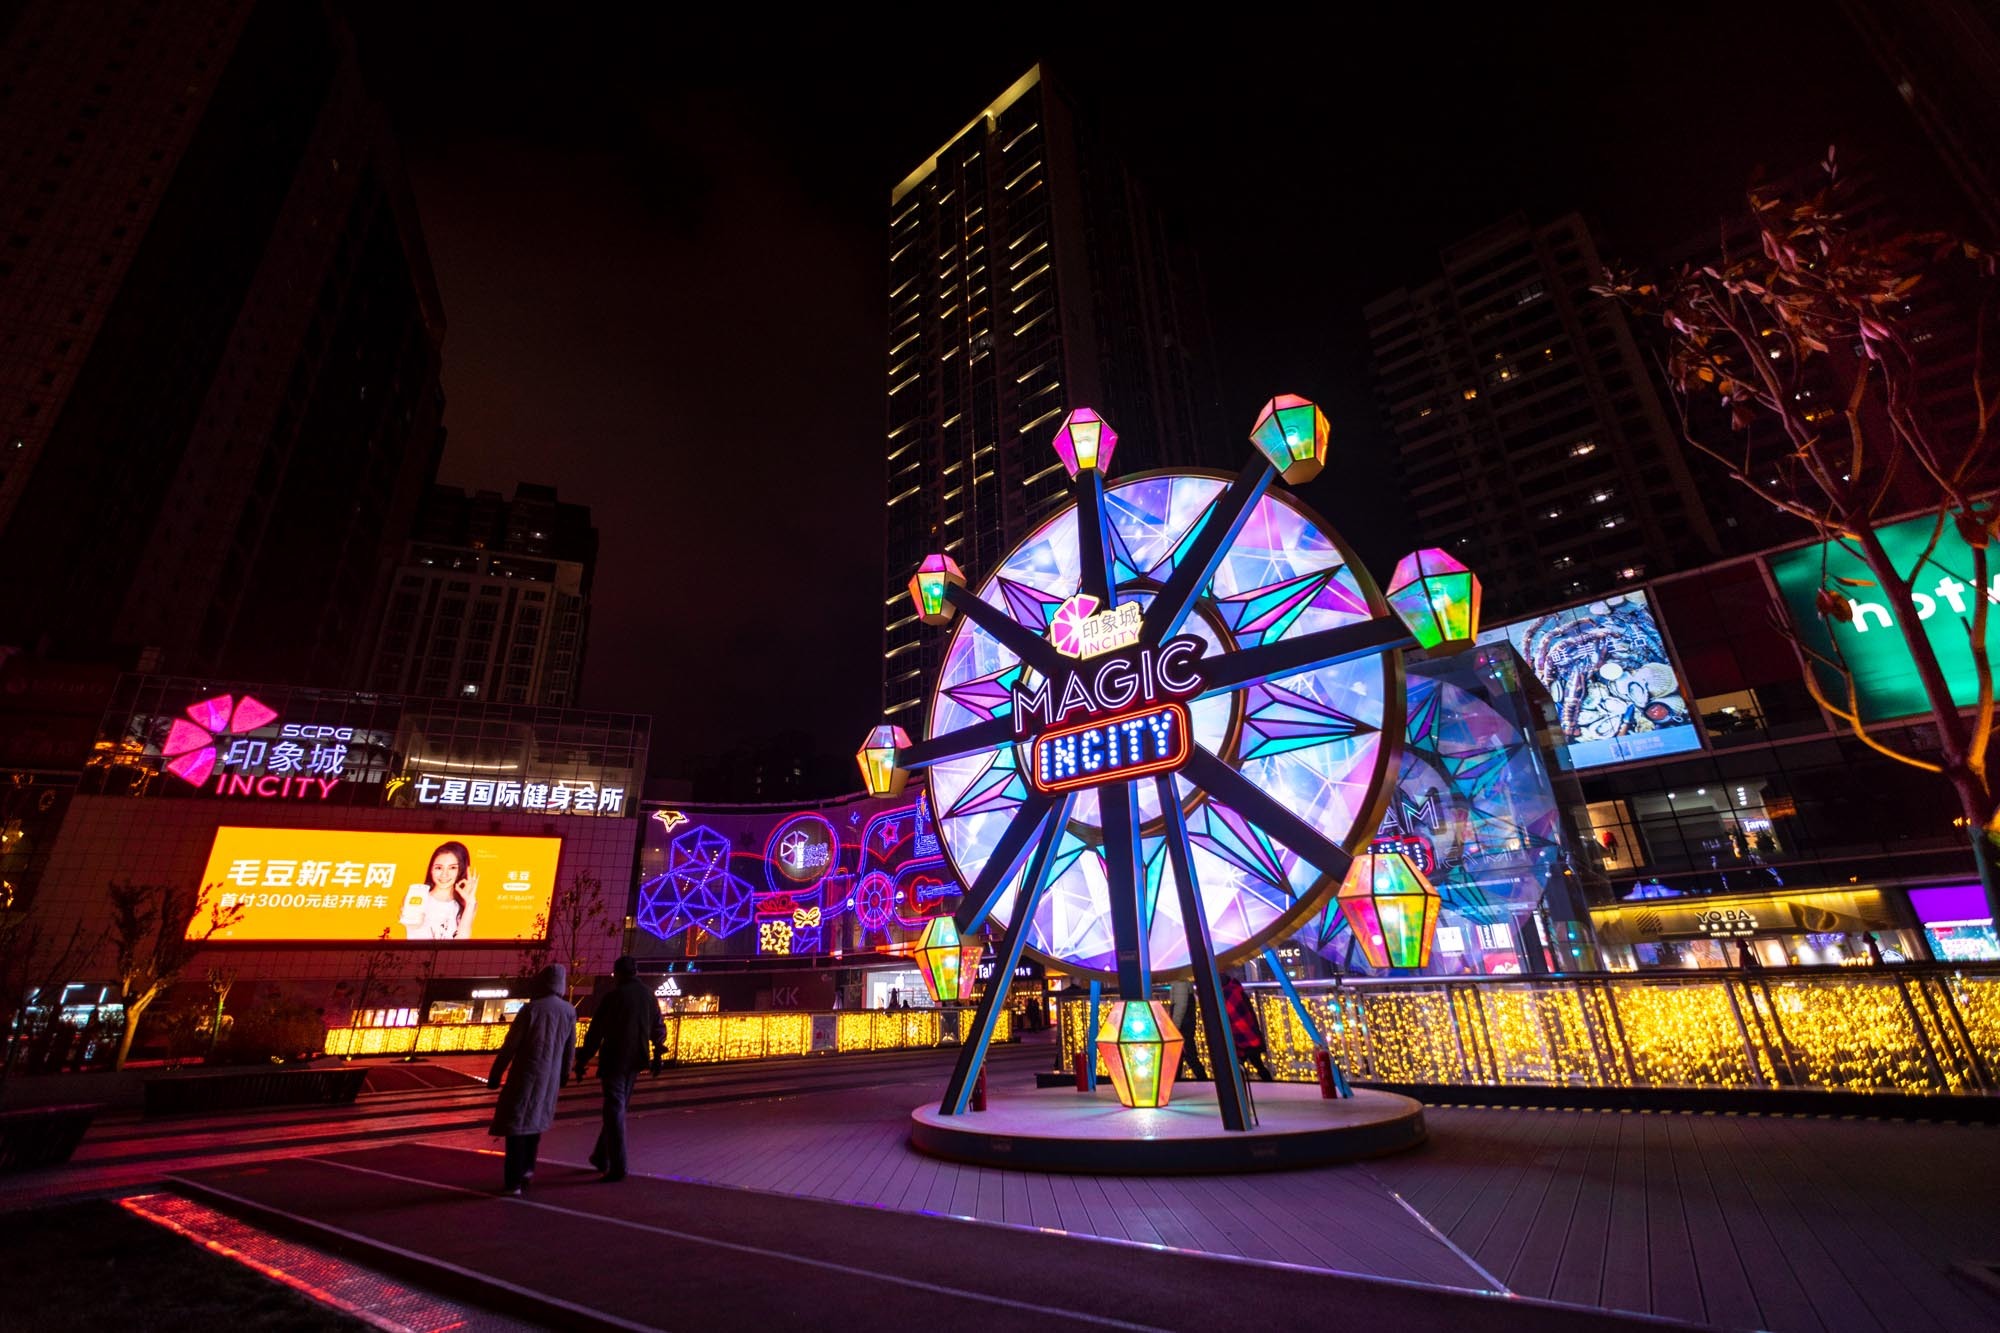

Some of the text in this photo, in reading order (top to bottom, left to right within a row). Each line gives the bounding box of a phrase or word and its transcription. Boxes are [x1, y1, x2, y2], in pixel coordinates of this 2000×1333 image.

[1082, 604, 1139, 639] 印象城
[1084, 627, 1140, 656] INCITY
[1013, 640, 1201, 733] MAGIC
[281, 724, 353, 740] SCPG
[1039, 709, 1174, 783] INCITY
[225, 739, 348, 774] 印象城
[215, 773, 340, 799] INCITY
[414, 778, 624, 812] 七星国际健身会所
[226, 859, 397, 888] 毛豆新车网
[220, 893, 389, 910] 首付3000元起开新车
